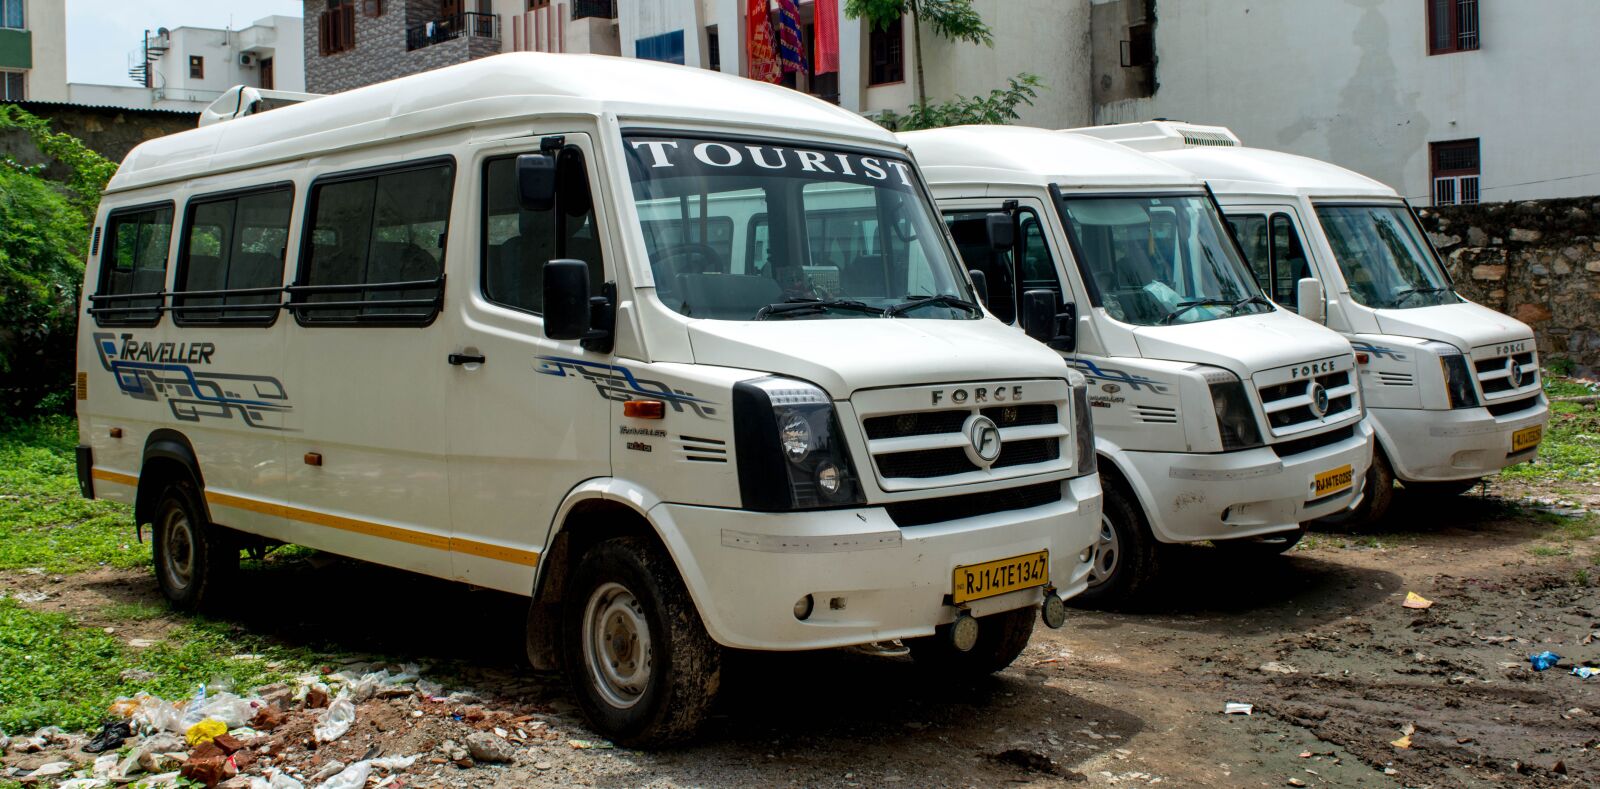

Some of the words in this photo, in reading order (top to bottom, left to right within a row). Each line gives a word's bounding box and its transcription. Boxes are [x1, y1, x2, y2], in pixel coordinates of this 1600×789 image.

[631, 140, 912, 187] TOURIST
[120, 333, 215, 364] TRAVELLER
[1496, 343, 1526, 355] FORCE
[1291, 360, 1335, 378] FORCE
[931, 385, 1023, 406] FORCE
[966, 556, 1046, 595] RJ14TE1347
